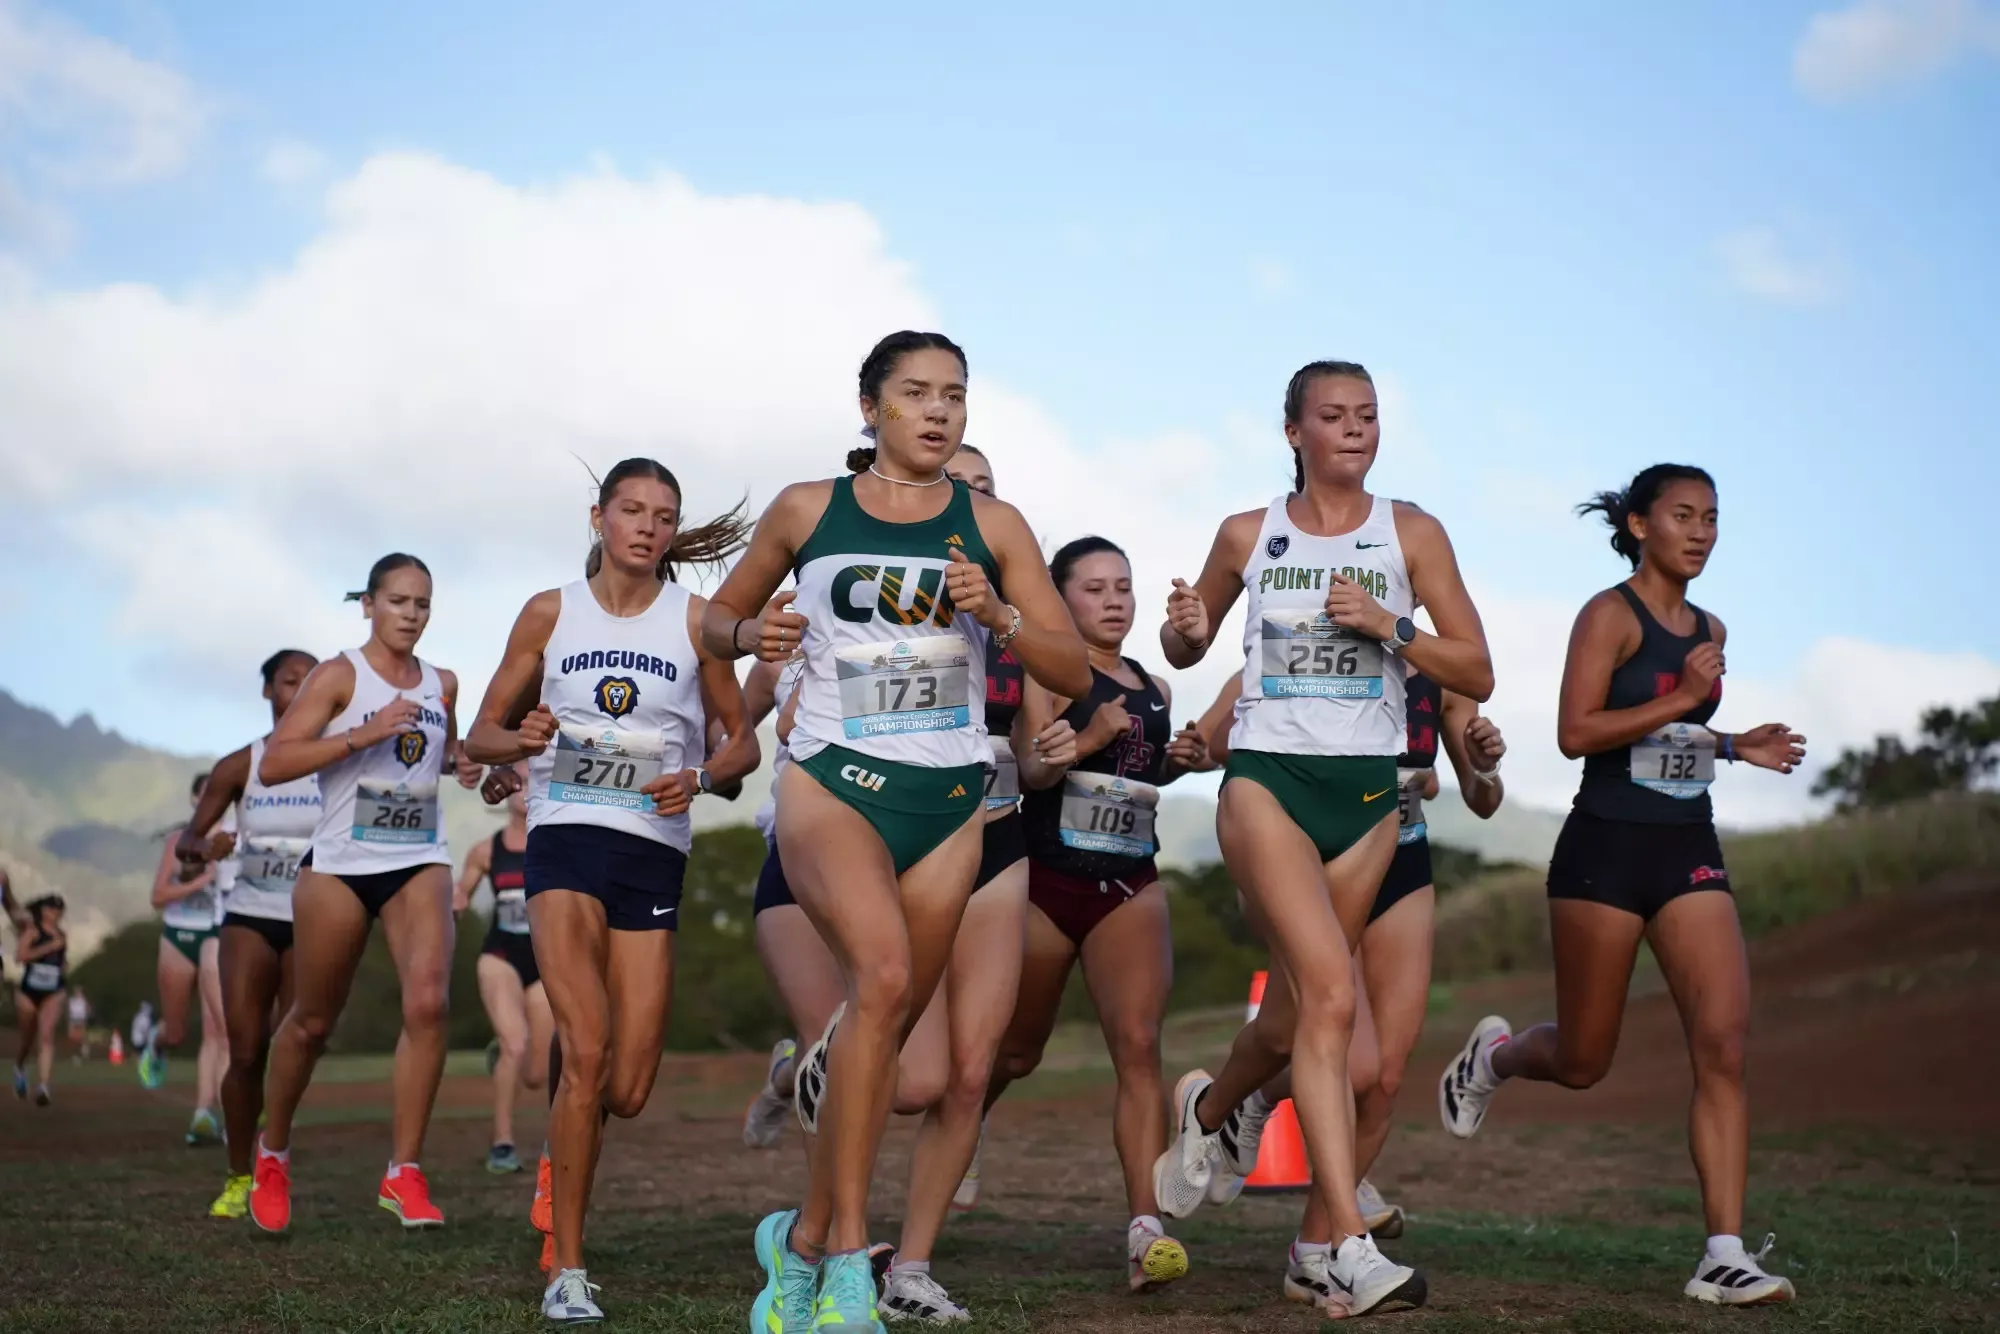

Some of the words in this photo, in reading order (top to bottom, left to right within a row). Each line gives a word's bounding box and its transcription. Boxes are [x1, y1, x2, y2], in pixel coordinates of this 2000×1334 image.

[1259, 567, 1325, 594] POINT
[831, 565, 956, 628] CUI
[561, 650, 678, 682] VANGUARD
[1288, 645, 1359, 676] 256
[873, 676, 937, 711] 173
[1277, 685, 1370, 695] CHAMPIONSHIPS
[861, 717, 956, 735] CHAMPIONSHIPS
[574, 757, 636, 788] 270
[840, 764, 887, 792] CUI
[1660, 753, 1696, 779] 132
[561, 791, 643, 808] CHAMPIONSHIPS
[372, 805, 423, 829] 266
[1089, 805, 1136, 834] 109
[1072, 838, 1144, 857] CHAMPIONSHIPS
